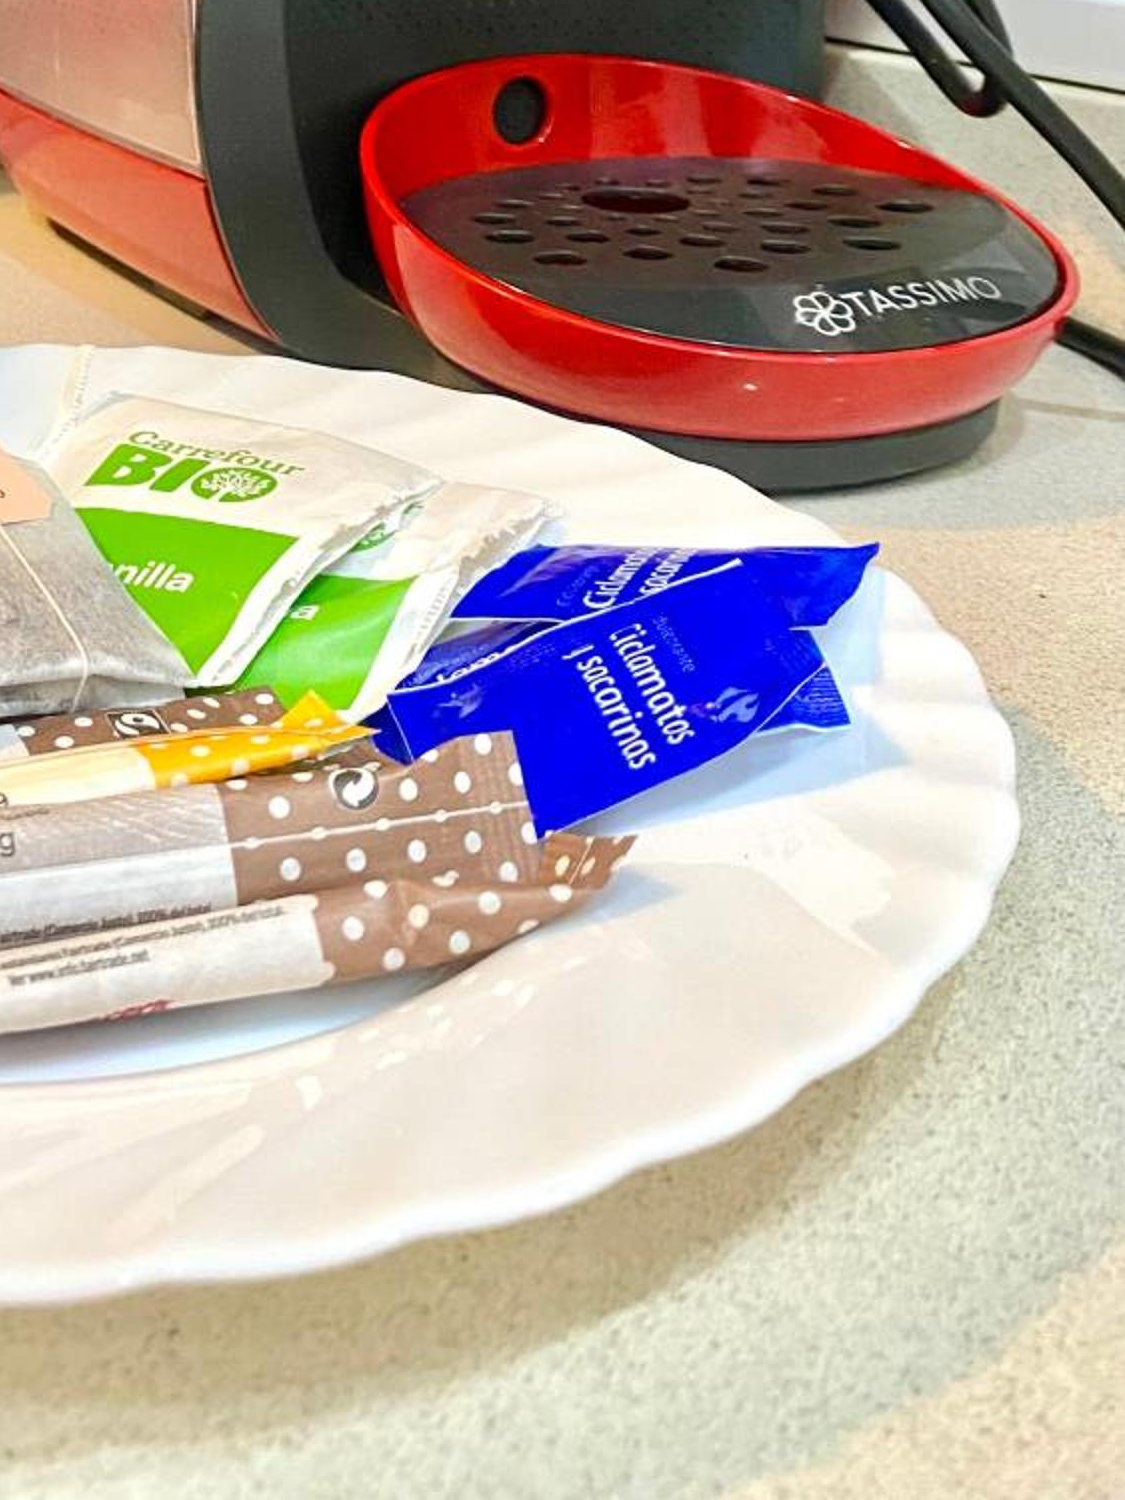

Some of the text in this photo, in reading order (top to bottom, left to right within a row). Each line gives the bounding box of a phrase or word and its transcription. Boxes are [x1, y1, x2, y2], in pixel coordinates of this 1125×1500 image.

[838, 277, 1002, 317] TASSIMO
[84, 443, 279, 503] BIO
[128, 430, 305, 477] Carrefour
[109, 560, 195, 593] nilla
[576, 656, 657, 771] sacarinas
